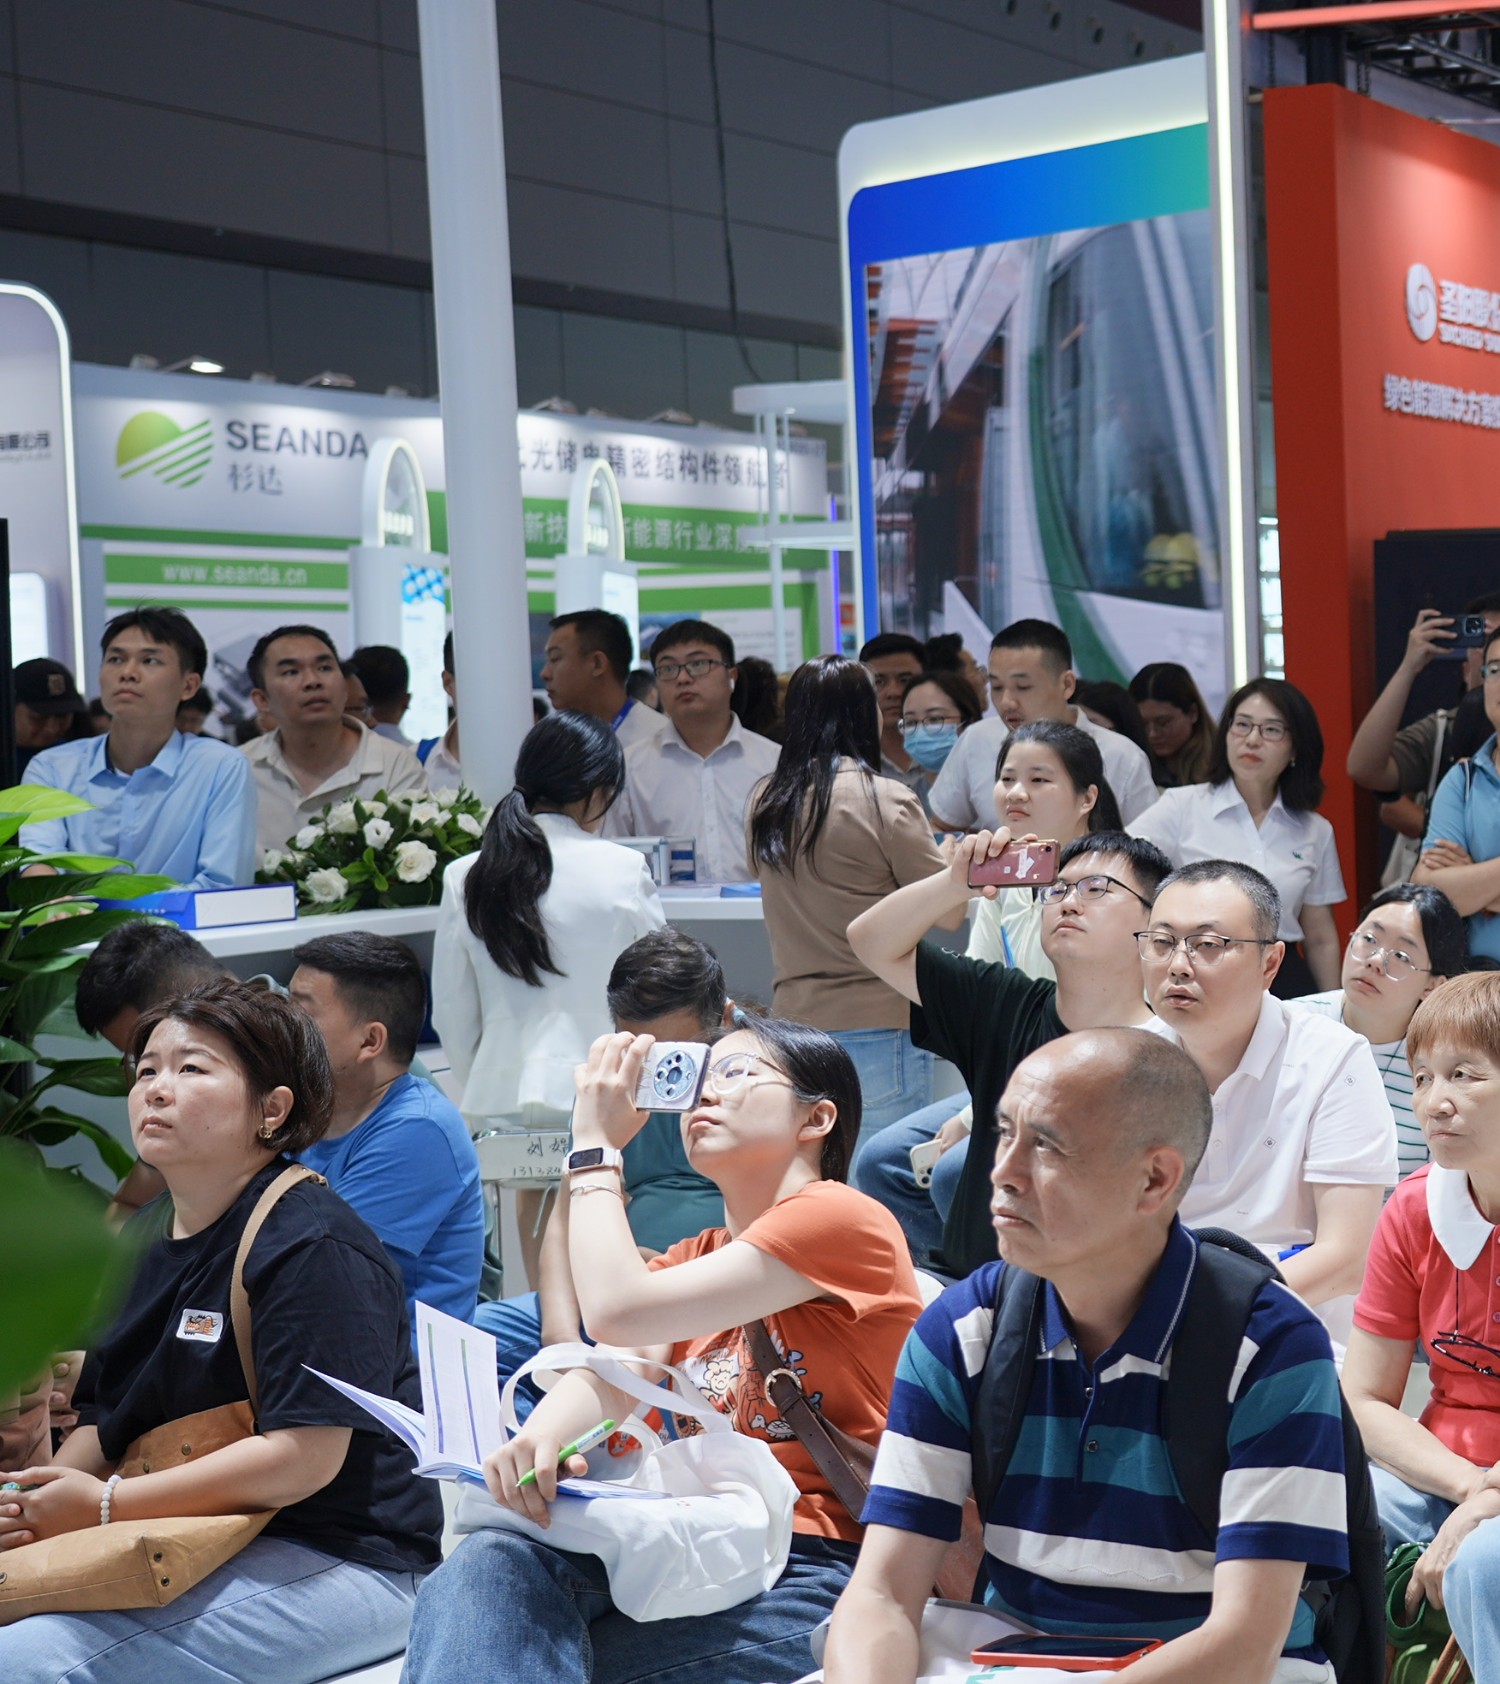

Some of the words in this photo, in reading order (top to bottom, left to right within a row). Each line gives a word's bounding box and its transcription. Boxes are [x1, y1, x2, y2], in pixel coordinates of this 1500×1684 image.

[226, 420, 369, 459] SEANDA
[227, 461, 284, 496] 杉达
[162, 564, 308, 586] www.seanda.cn
